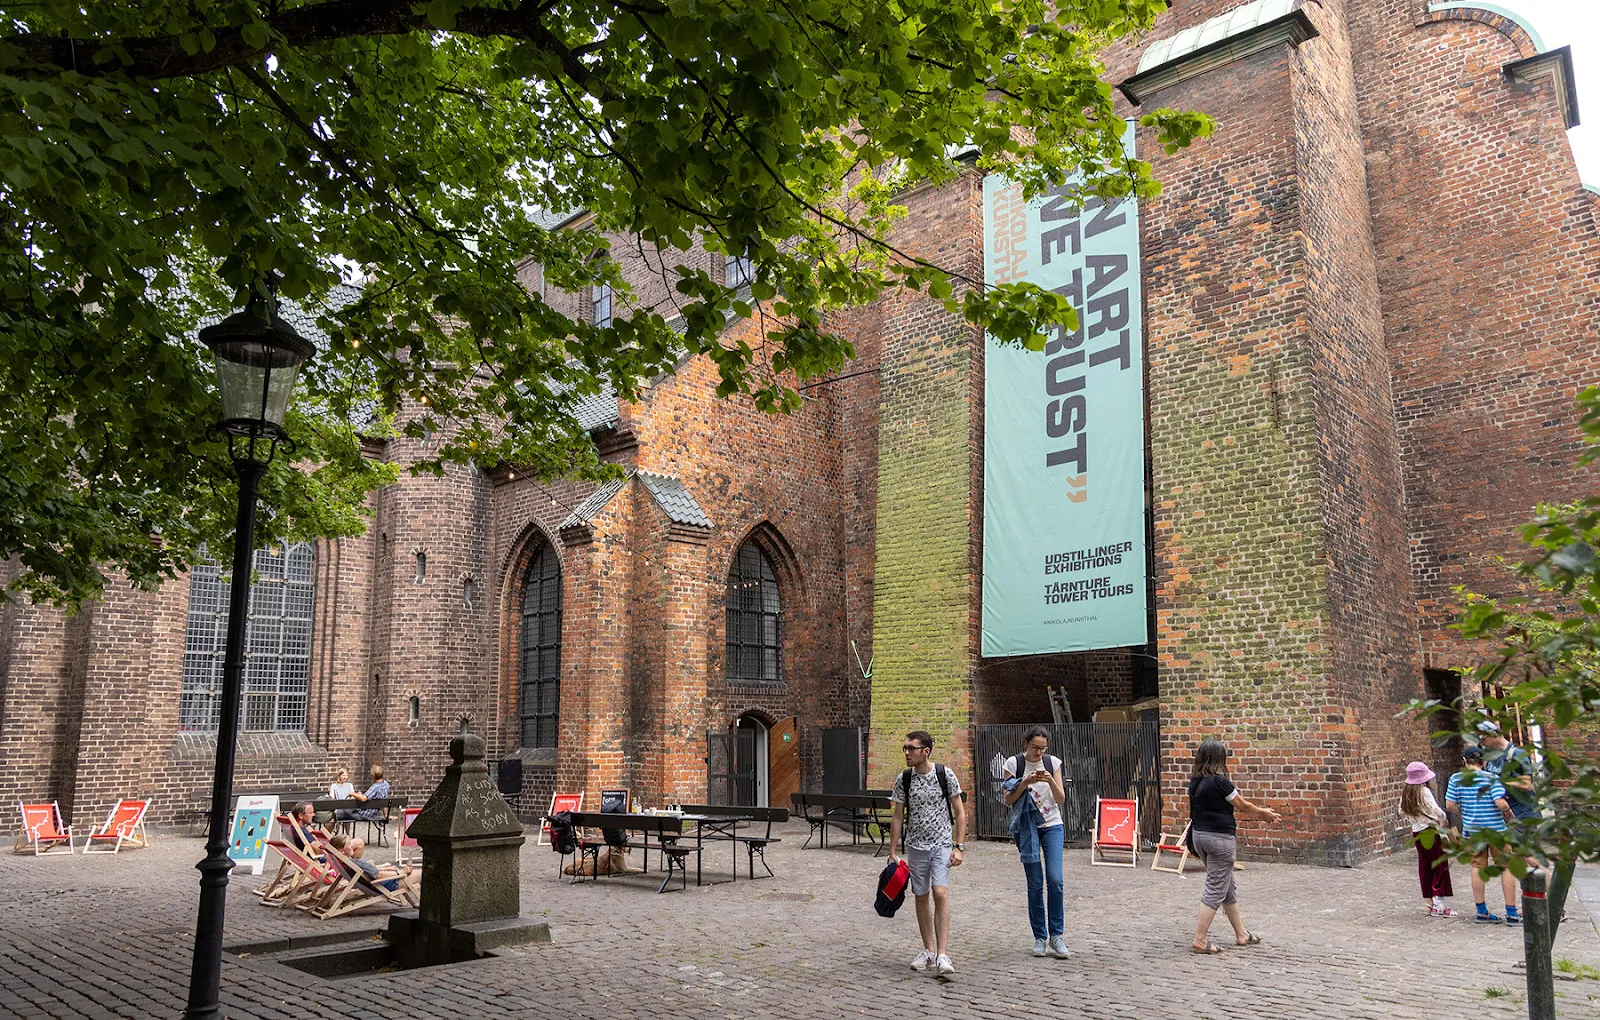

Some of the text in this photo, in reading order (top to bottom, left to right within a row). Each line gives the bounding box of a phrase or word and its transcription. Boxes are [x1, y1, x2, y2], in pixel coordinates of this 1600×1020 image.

[1040, 164, 1082, 266] WE
[992, 189, 1011, 286] KUNSTH
[1010, 181, 1028, 280] NIKOLAJ
[1084, 168, 1131, 371] N ART
[1044, 554, 1122, 575] EXHIBITIONS
[1045, 541, 1133, 565] UDSTILLINGER
[1044, 576, 1111, 595] TÅRNTURE
[1044, 583, 1134, 605] TOWER TOURS
[480, 811, 509, 830] BODY
